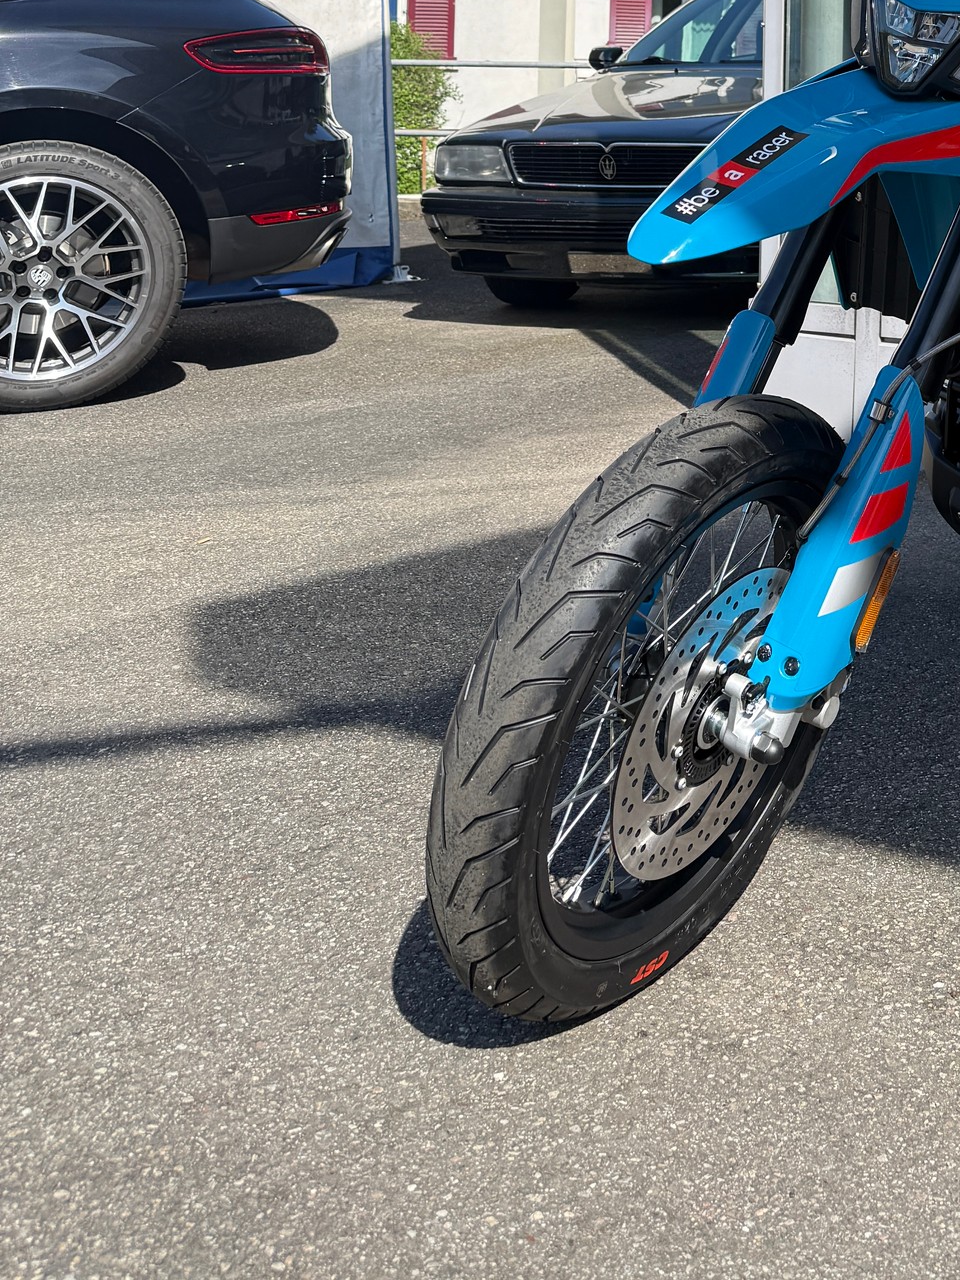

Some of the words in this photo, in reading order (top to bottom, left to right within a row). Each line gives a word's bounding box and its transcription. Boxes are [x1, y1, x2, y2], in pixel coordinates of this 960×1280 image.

[17, 154, 76, 165] LATITUDE
[78, 159, 110, 174] Sport
[675, 186, 720, 215] #be
[724, 169, 745, 181] a
[746, 131, 793, 165] racer
[630, 950, 670, 985] CST
